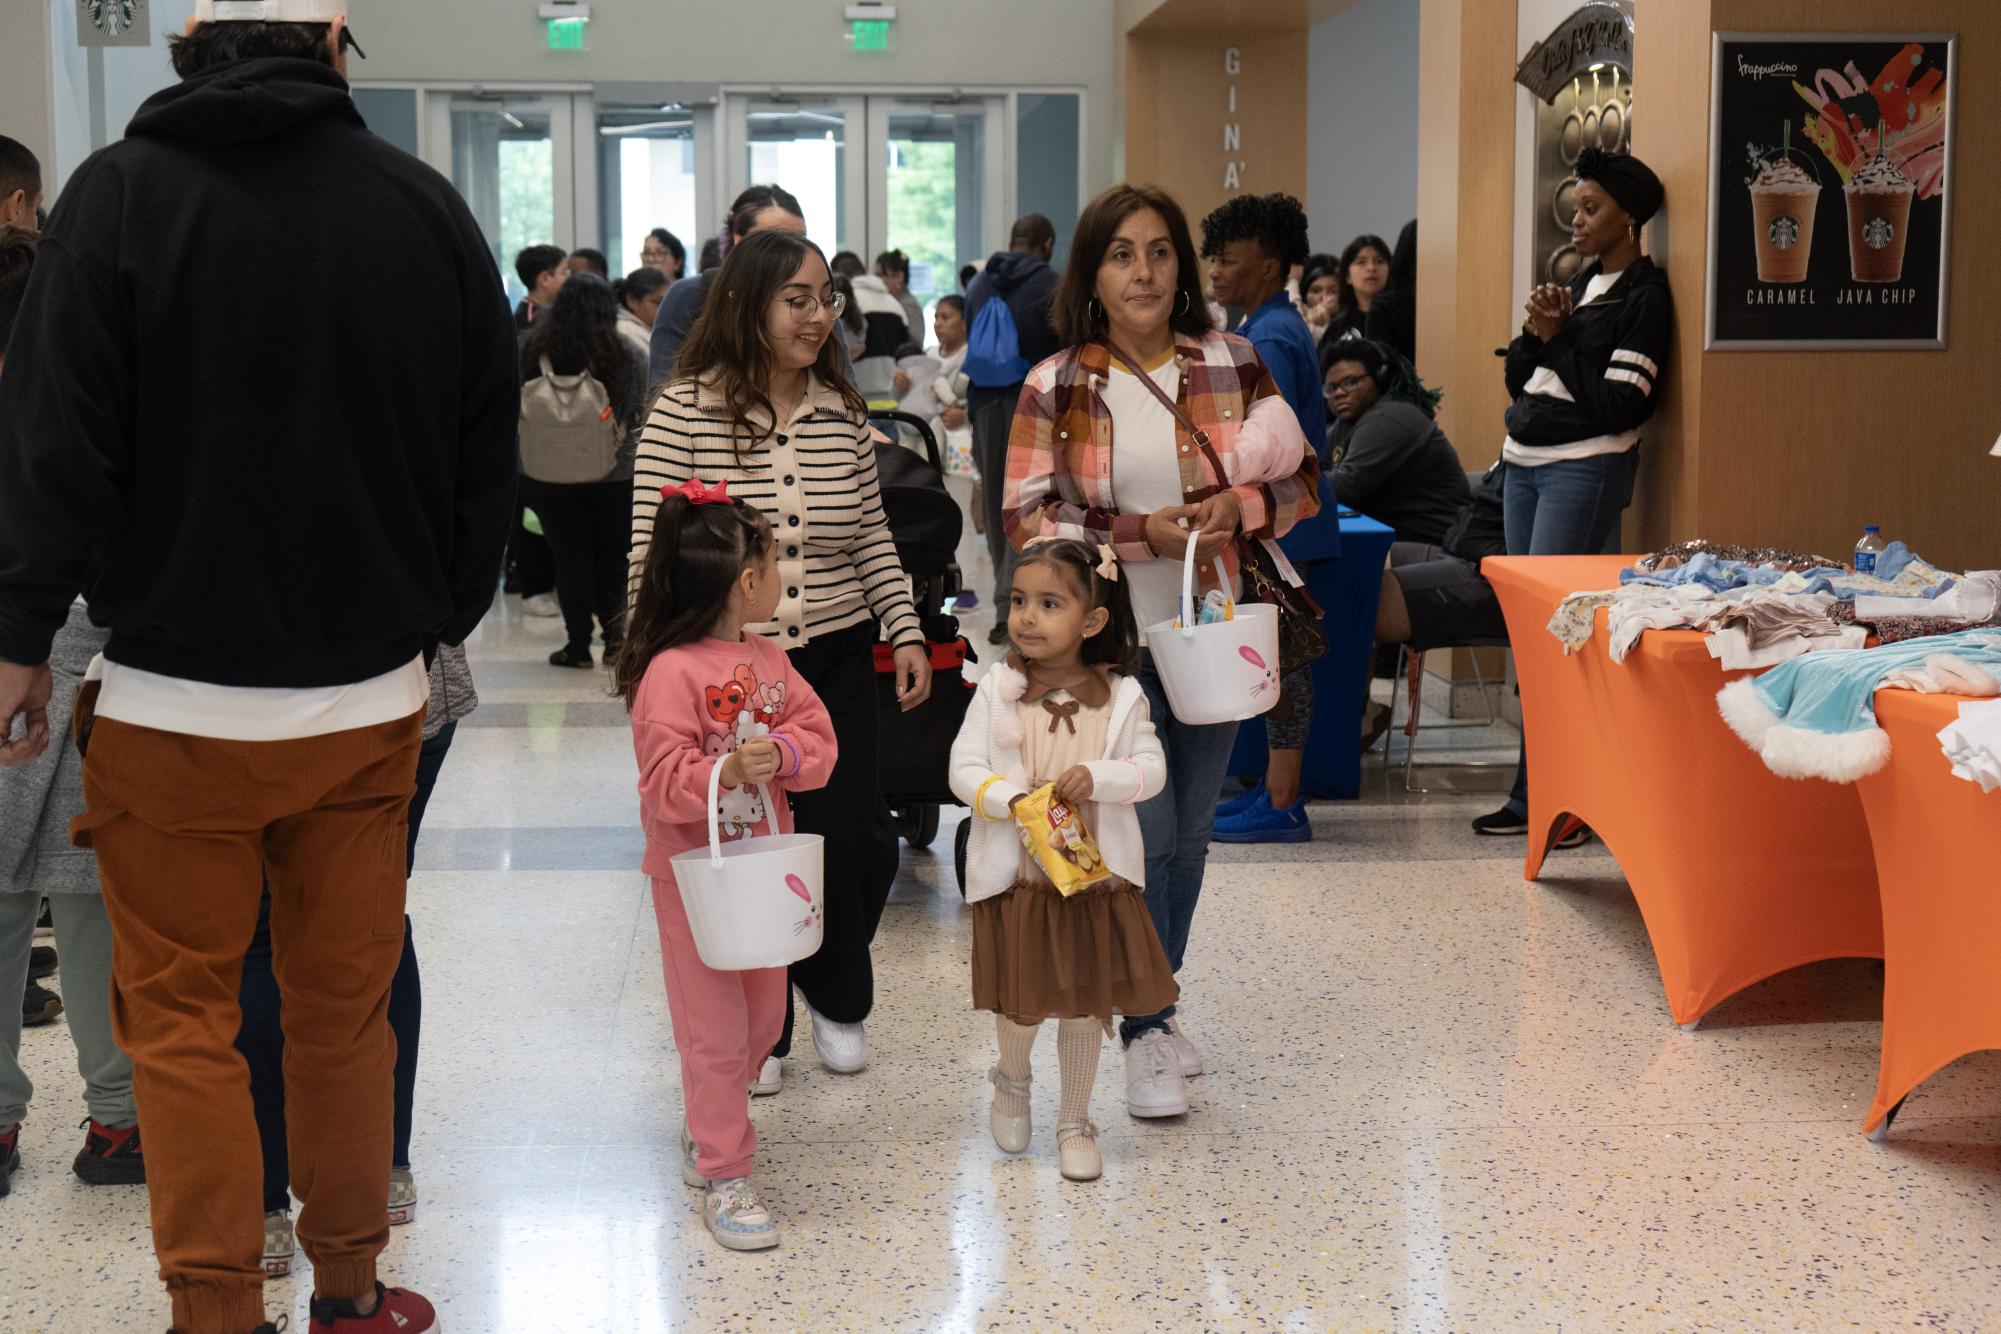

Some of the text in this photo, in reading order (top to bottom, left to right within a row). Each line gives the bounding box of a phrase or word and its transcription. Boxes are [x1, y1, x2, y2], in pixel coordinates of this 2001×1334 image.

[1224, 48, 1245, 189] GINA'
[1747, 289, 1815, 305] CARAMEL
[1837, 289, 1916, 304] JAVA CHIP
